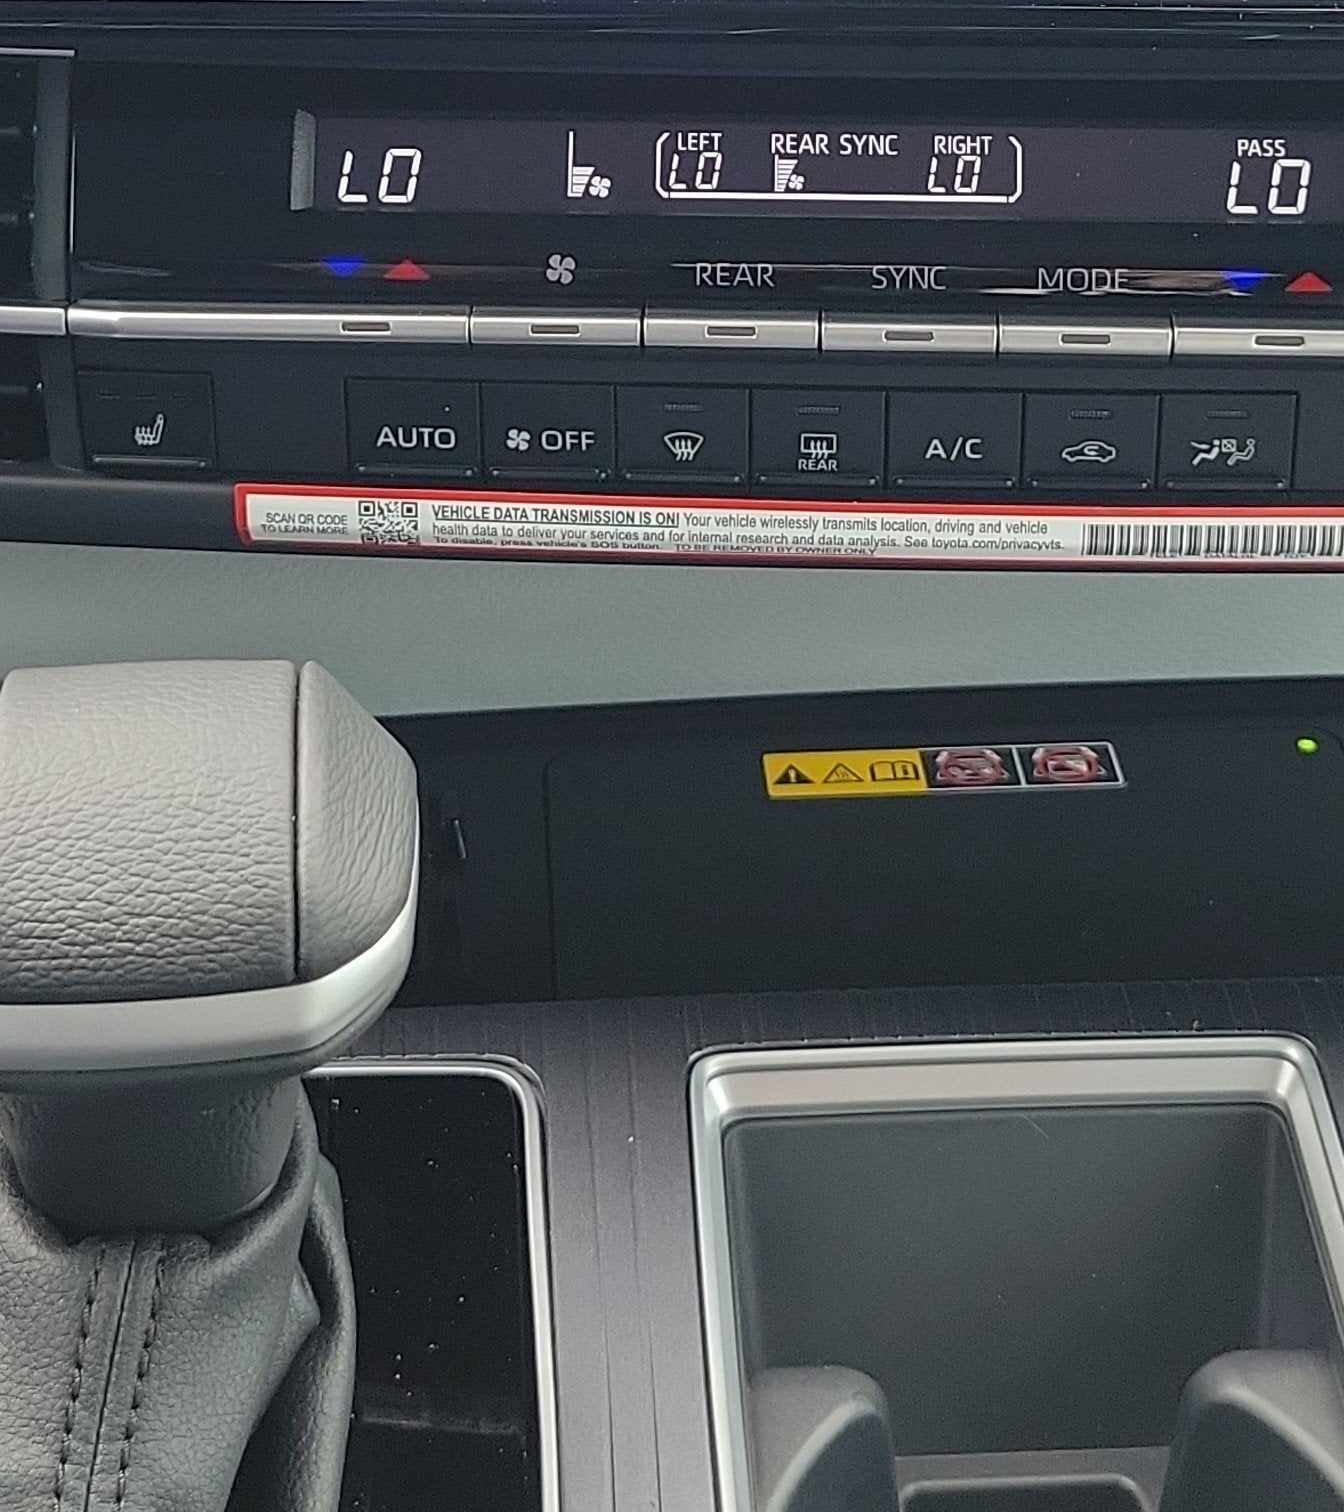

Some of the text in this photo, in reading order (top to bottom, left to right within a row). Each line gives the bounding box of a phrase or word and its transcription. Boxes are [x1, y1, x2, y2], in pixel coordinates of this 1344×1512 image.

[677, 132, 722, 151] LEFT
[770, 134, 898, 156] REAR SYNC
[934, 136, 992, 155] RIGHT
[1236, 139, 1286, 158] PASS
[337, 147, 422, 203] LO
[669, 152, 722, 189] LO
[927, 155, 981, 193] LO
[1226, 158, 1310, 215] LO
[695, 263, 775, 287] REAR
[871, 266, 947, 290] SYNC
[1037, 268, 1129, 292] MODE
[376, 426, 456, 449] AUTO
[540, 428, 595, 452] OFF
[925, 437, 983, 461] A/C
[798, 459, 837, 471] REAR
[261, 524, 349, 535] TO LEARN MORE
[266, 512, 348, 526] SCAN QR CODE
[432, 504, 489, 519] VEHICLE
[494, 506, 529, 520] DATA
[532, 508, 635, 524] TRANSMISSION
[639, 511, 652, 524] IS
[684, 512, 712, 526] Your
[714, 514, 756, 528] vehicle
[760, 515, 818, 532] wirelessly
[822, 516, 878, 531] transmits
[880, 517, 931, 534] location,
[935, 519, 975, 535] driving
[979, 520, 1001, 533] and
[1006, 520, 1048, 534] vehicle
[432, 523, 469, 536] health
[472, 523, 498, 536] data
[502, 524, 513, 536] to
[517, 525, 556, 538] deliver
[560, 528, 587, 541] your
[590, 528, 639, 540] services
[643, 529, 665, 540] and
[668, 529, 685, 542] for
[688, 529, 733, 543] internal
[736, 531, 789, 545] research
[792, 533, 814, 545] and
[818, 534, 844, 546] data
[847, 535, 900, 549] analysis.
[905, 536, 928, 548] See
